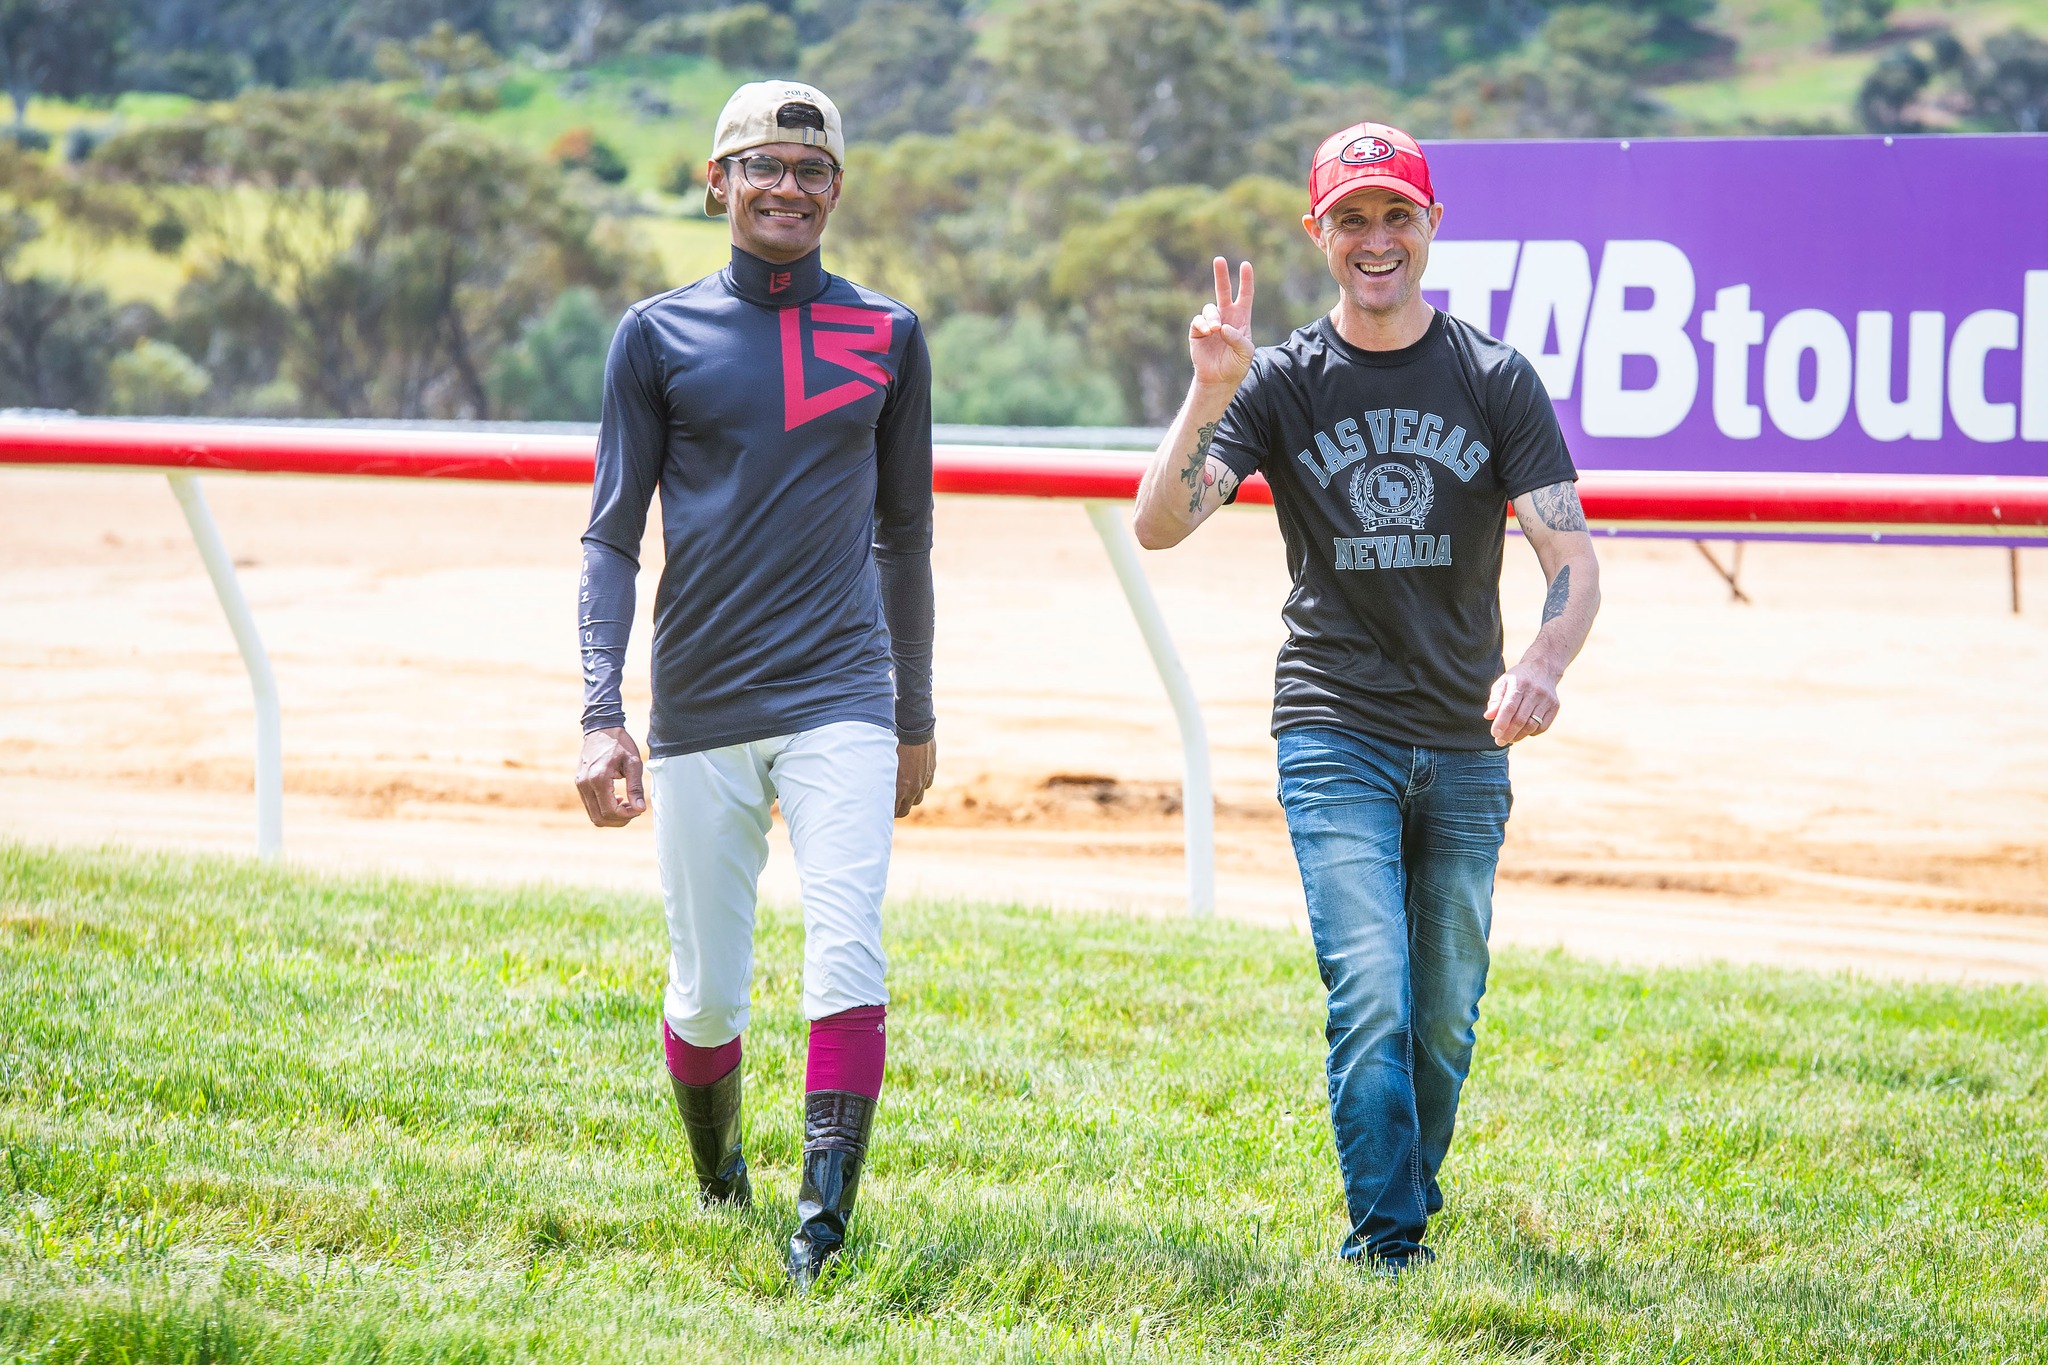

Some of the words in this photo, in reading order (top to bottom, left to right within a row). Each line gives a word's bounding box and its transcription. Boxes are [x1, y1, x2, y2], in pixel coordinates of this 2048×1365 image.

[784, 90, 811, 98] POLO
[1298, 417, 1367, 489] LAS
[1365, 408, 1490, 483] VEGAS
[1334, 534, 1452, 570] NEVADA
